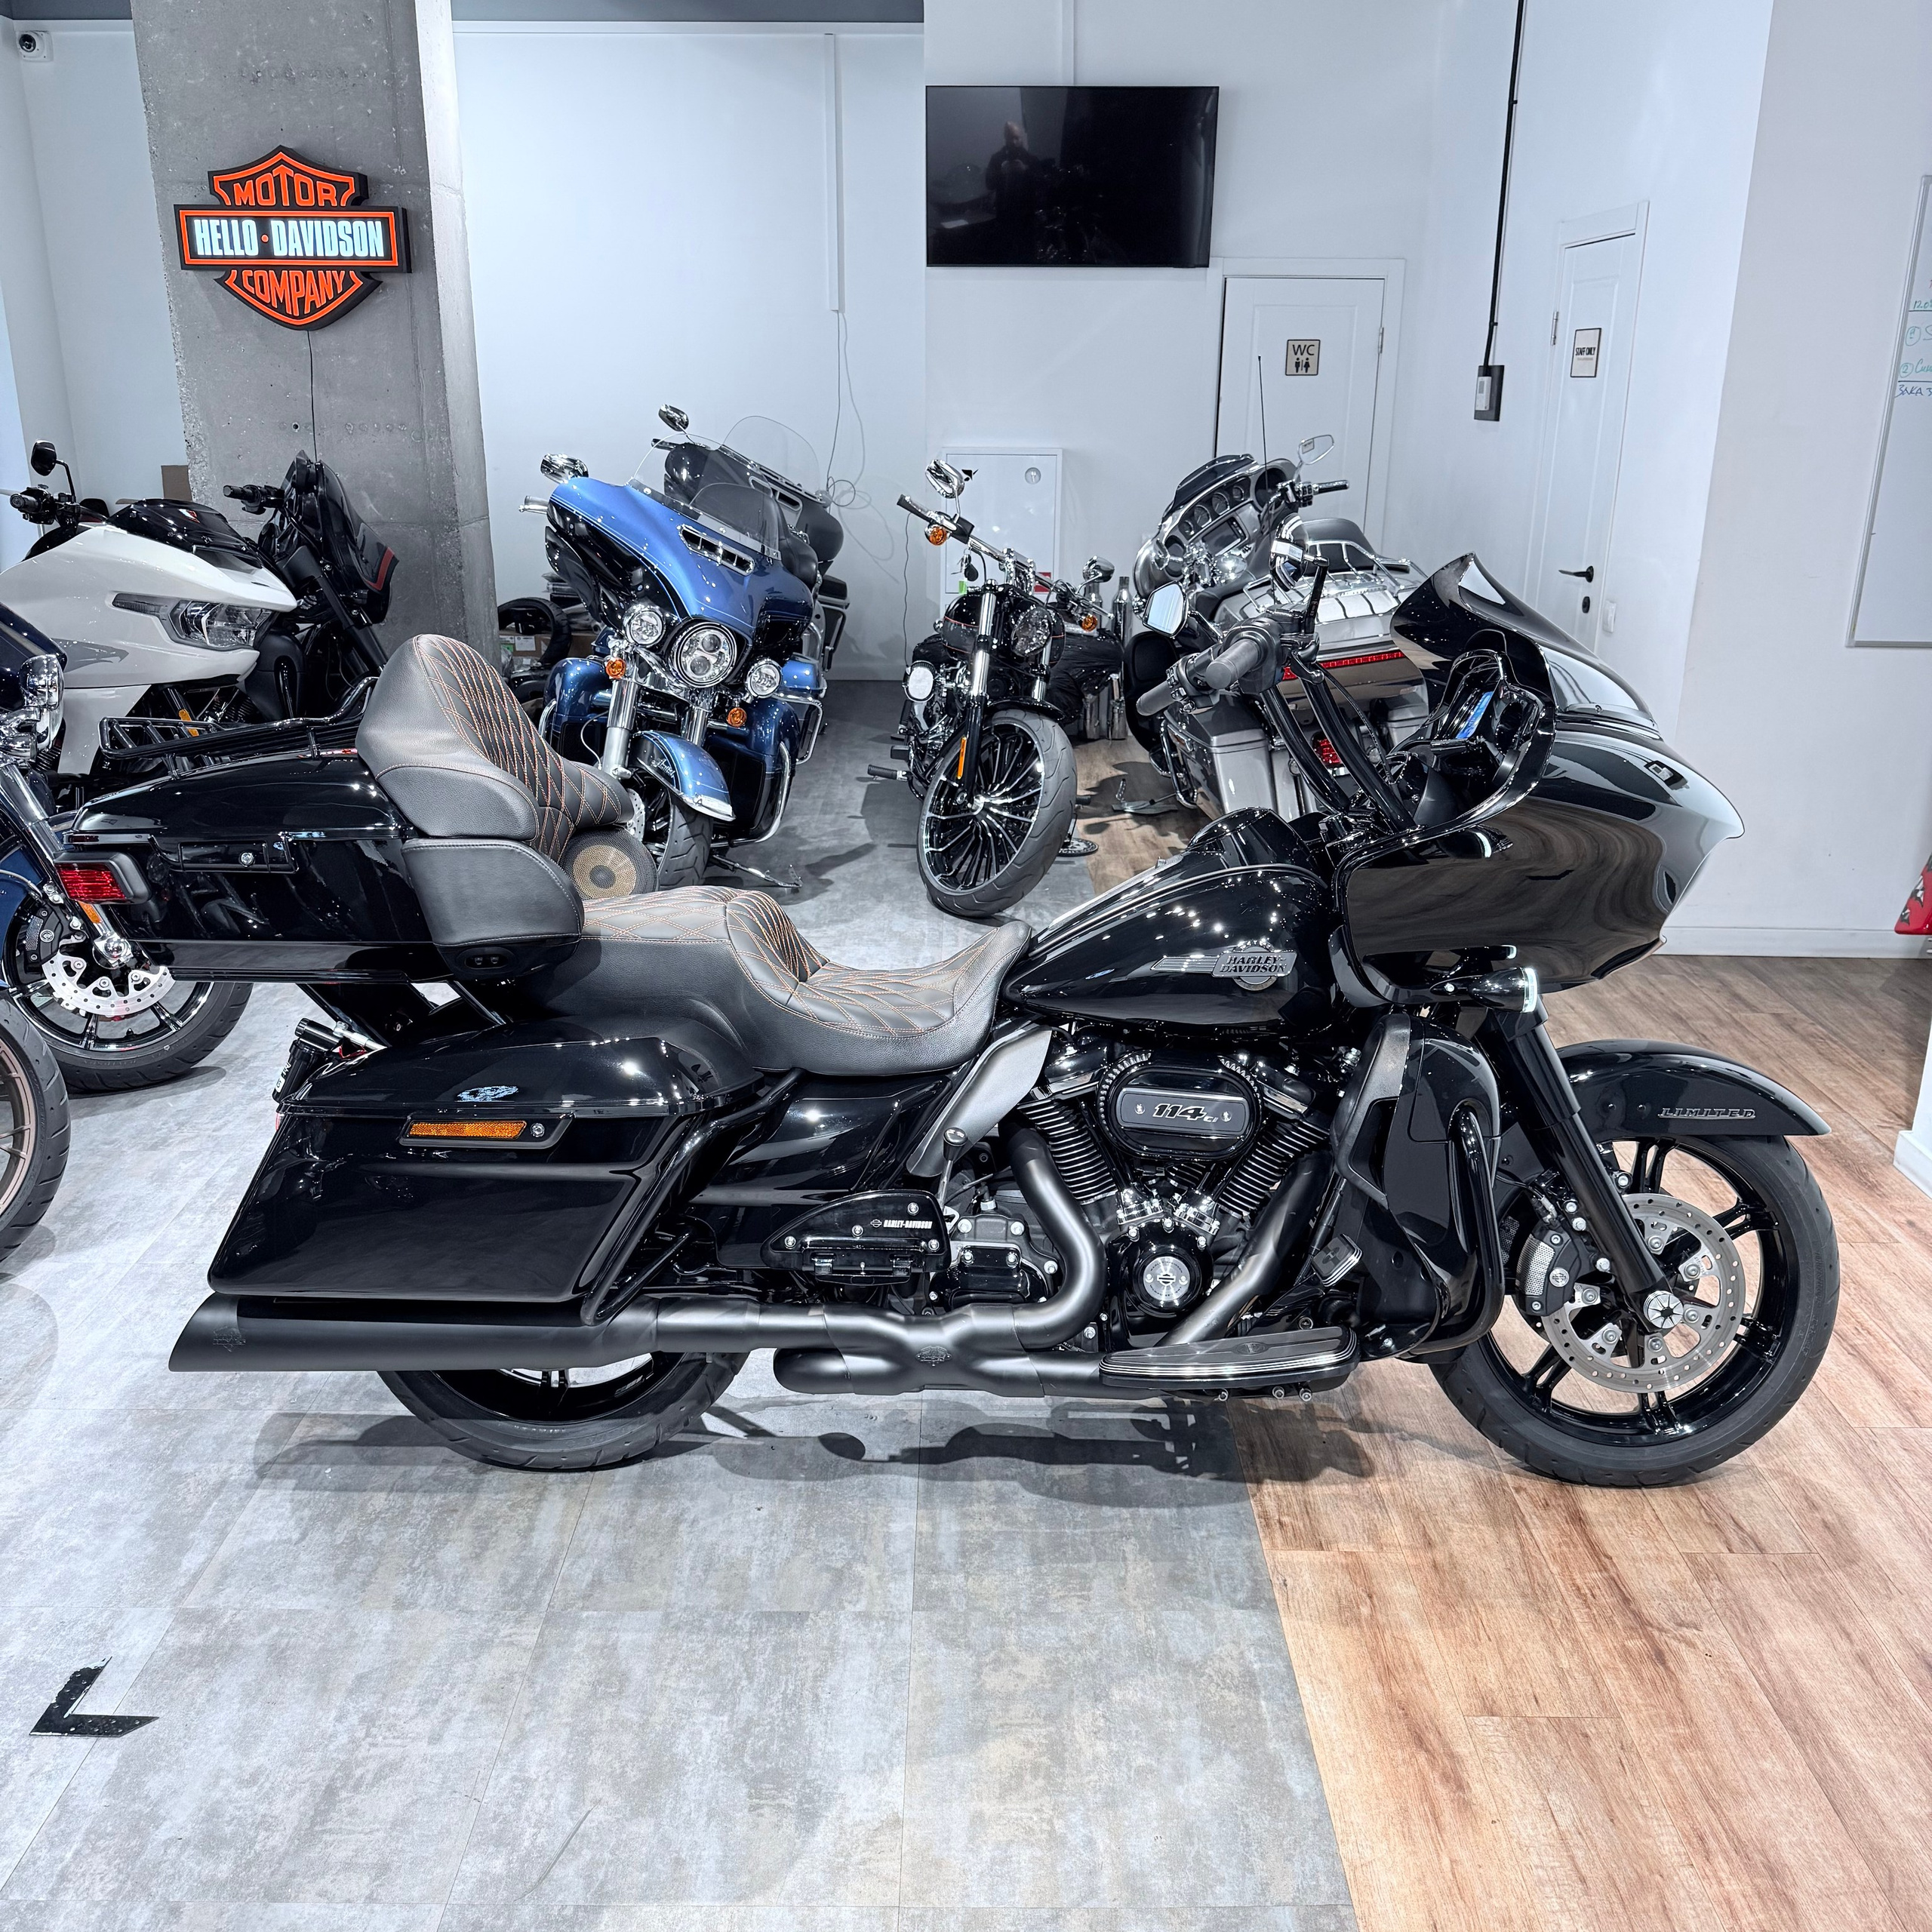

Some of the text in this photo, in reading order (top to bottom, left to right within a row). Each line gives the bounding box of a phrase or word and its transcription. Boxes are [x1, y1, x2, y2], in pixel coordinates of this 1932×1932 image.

[233, 165, 337, 207] MOTOR
[194, 220, 385, 257] HELLO DAVIDSON
[242, 270, 345, 316] COMPANY
[1292, 344, 1315, 355] WC
[1575, 347, 1596, 355] STAFF ONLY
[1220, 964, 1287, 973] DAVIDSON
[1658, 1107, 1756, 1119] LIMITED
